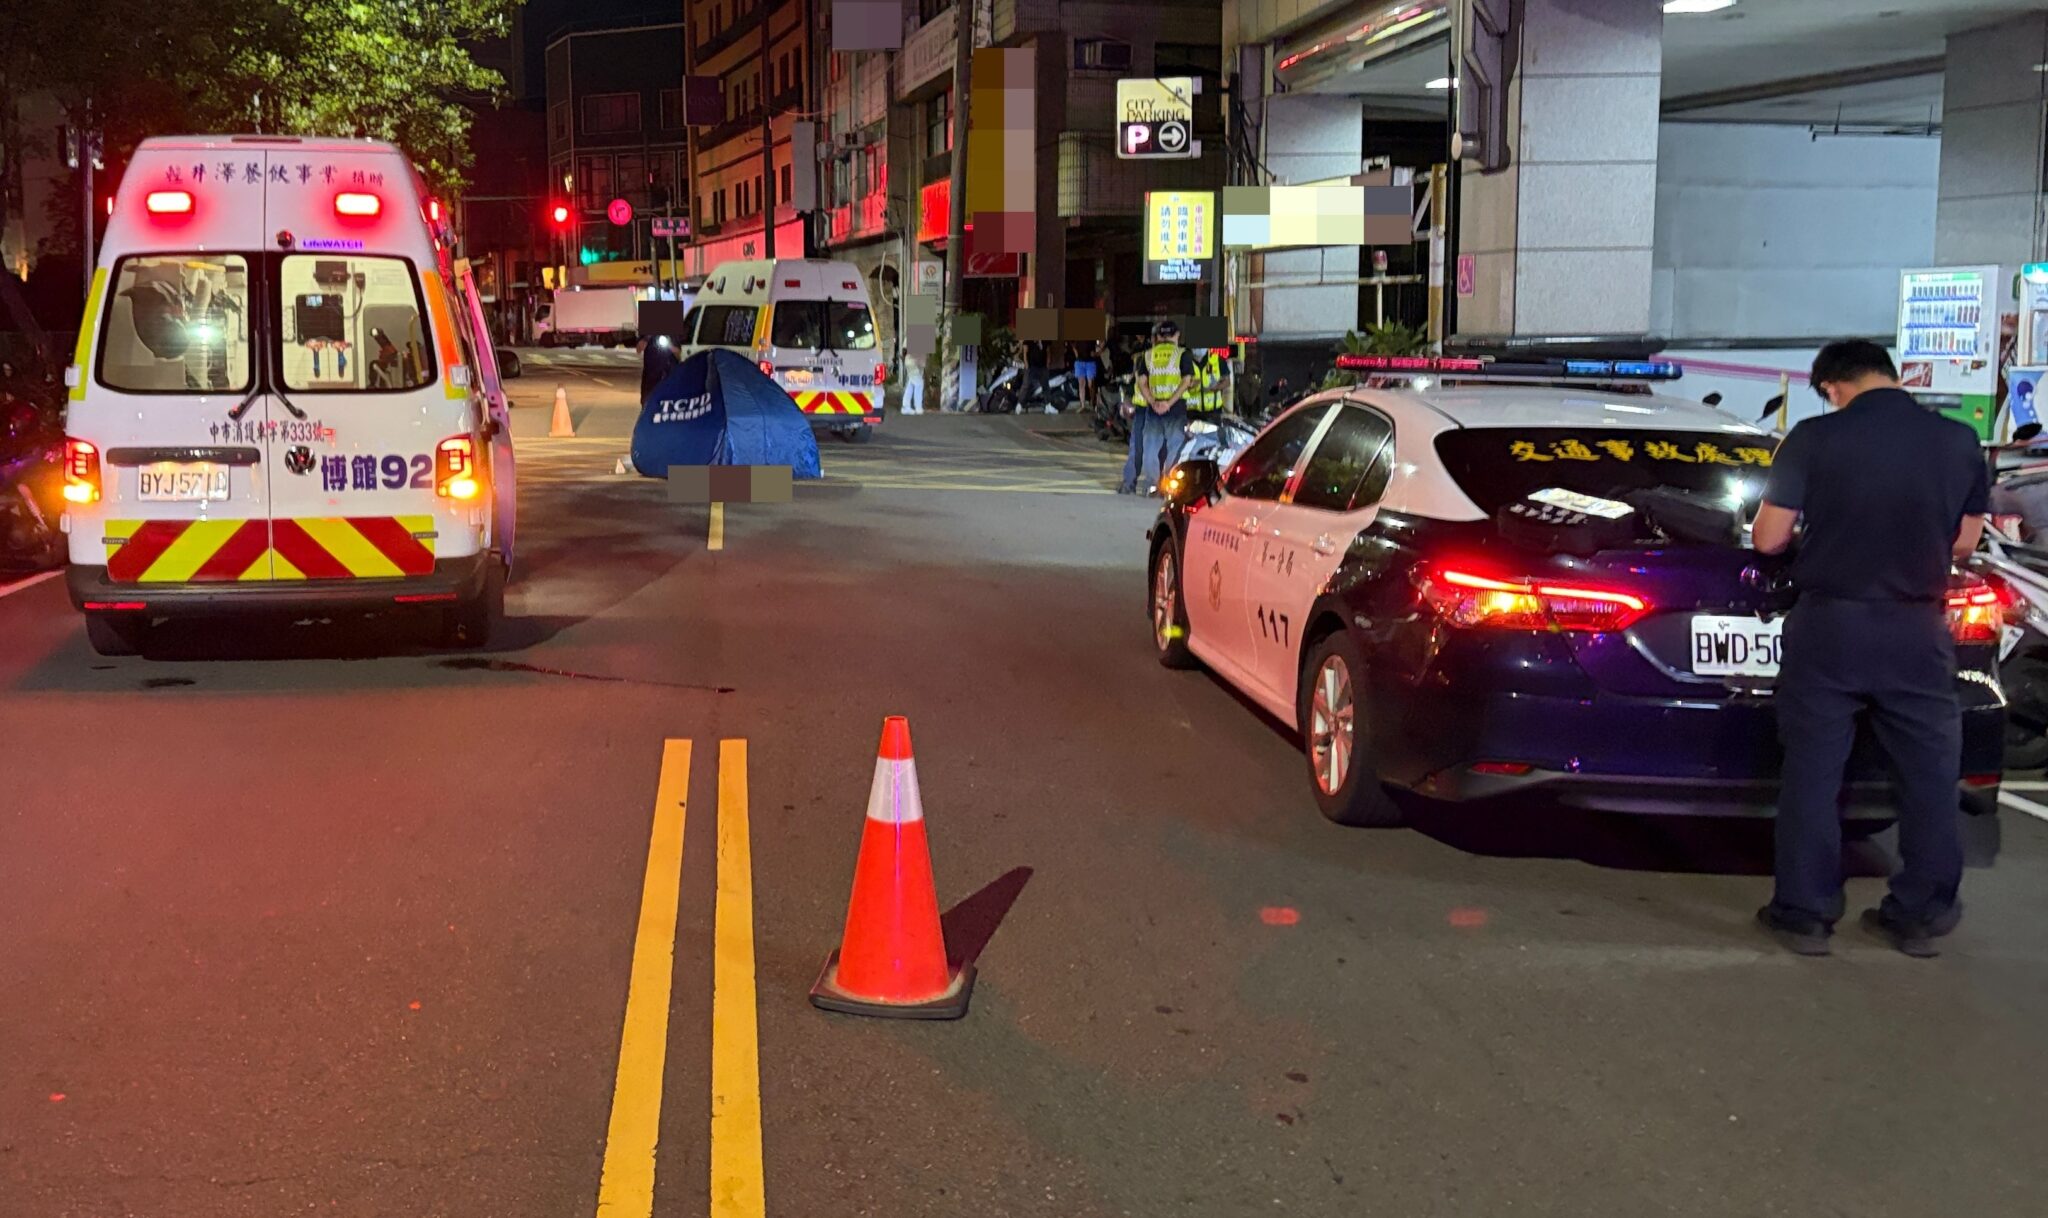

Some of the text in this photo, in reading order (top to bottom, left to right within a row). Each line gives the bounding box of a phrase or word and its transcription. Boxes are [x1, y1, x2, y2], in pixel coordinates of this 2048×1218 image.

[1126, 99, 1156, 112] CITY
[1126, 109, 1185, 122] PARKING
[1127, 125, 1150, 153] P
[660, 392, 711, 413] TCPD
[1510, 438, 1773, 468] 交通事故處理
[320, 453, 433, 492] 博館92
[1257, 603, 1289, 650] 117
